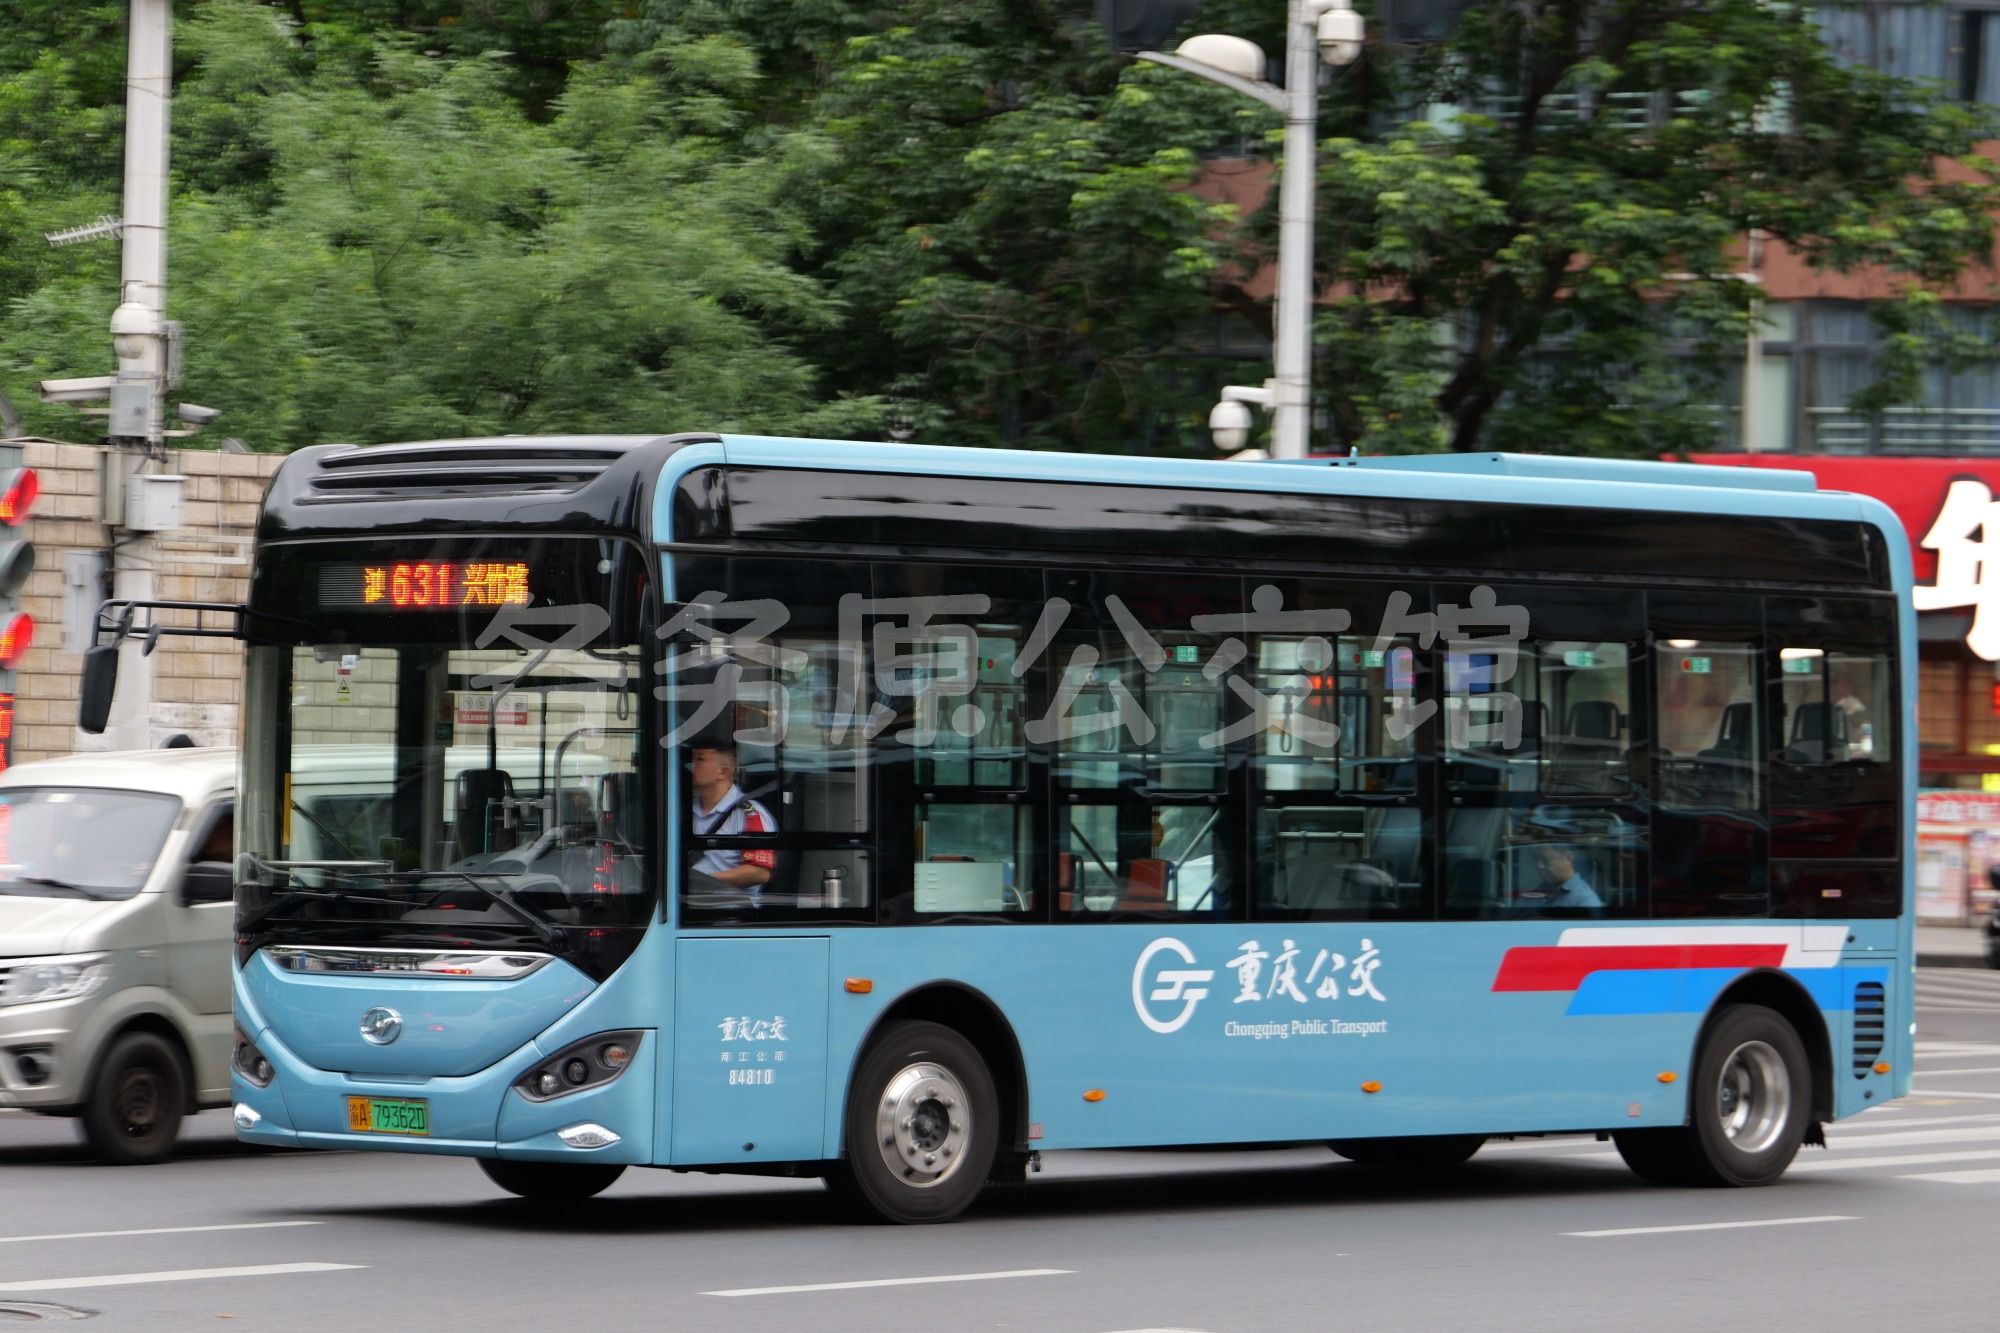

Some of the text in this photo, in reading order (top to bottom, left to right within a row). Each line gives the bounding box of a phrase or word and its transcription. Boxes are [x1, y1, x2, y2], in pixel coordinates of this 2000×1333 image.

[393, 564, 450, 606] 631
[1226, 938, 1387, 1003] 重庆公交
[718, 1015, 787, 1041] 重庆公交
[1225, 1019, 1388, 1039] Chongqing Public Transport
[720, 1051, 784, 1062] 两江公司
[729, 1068, 774, 1085] 84810
